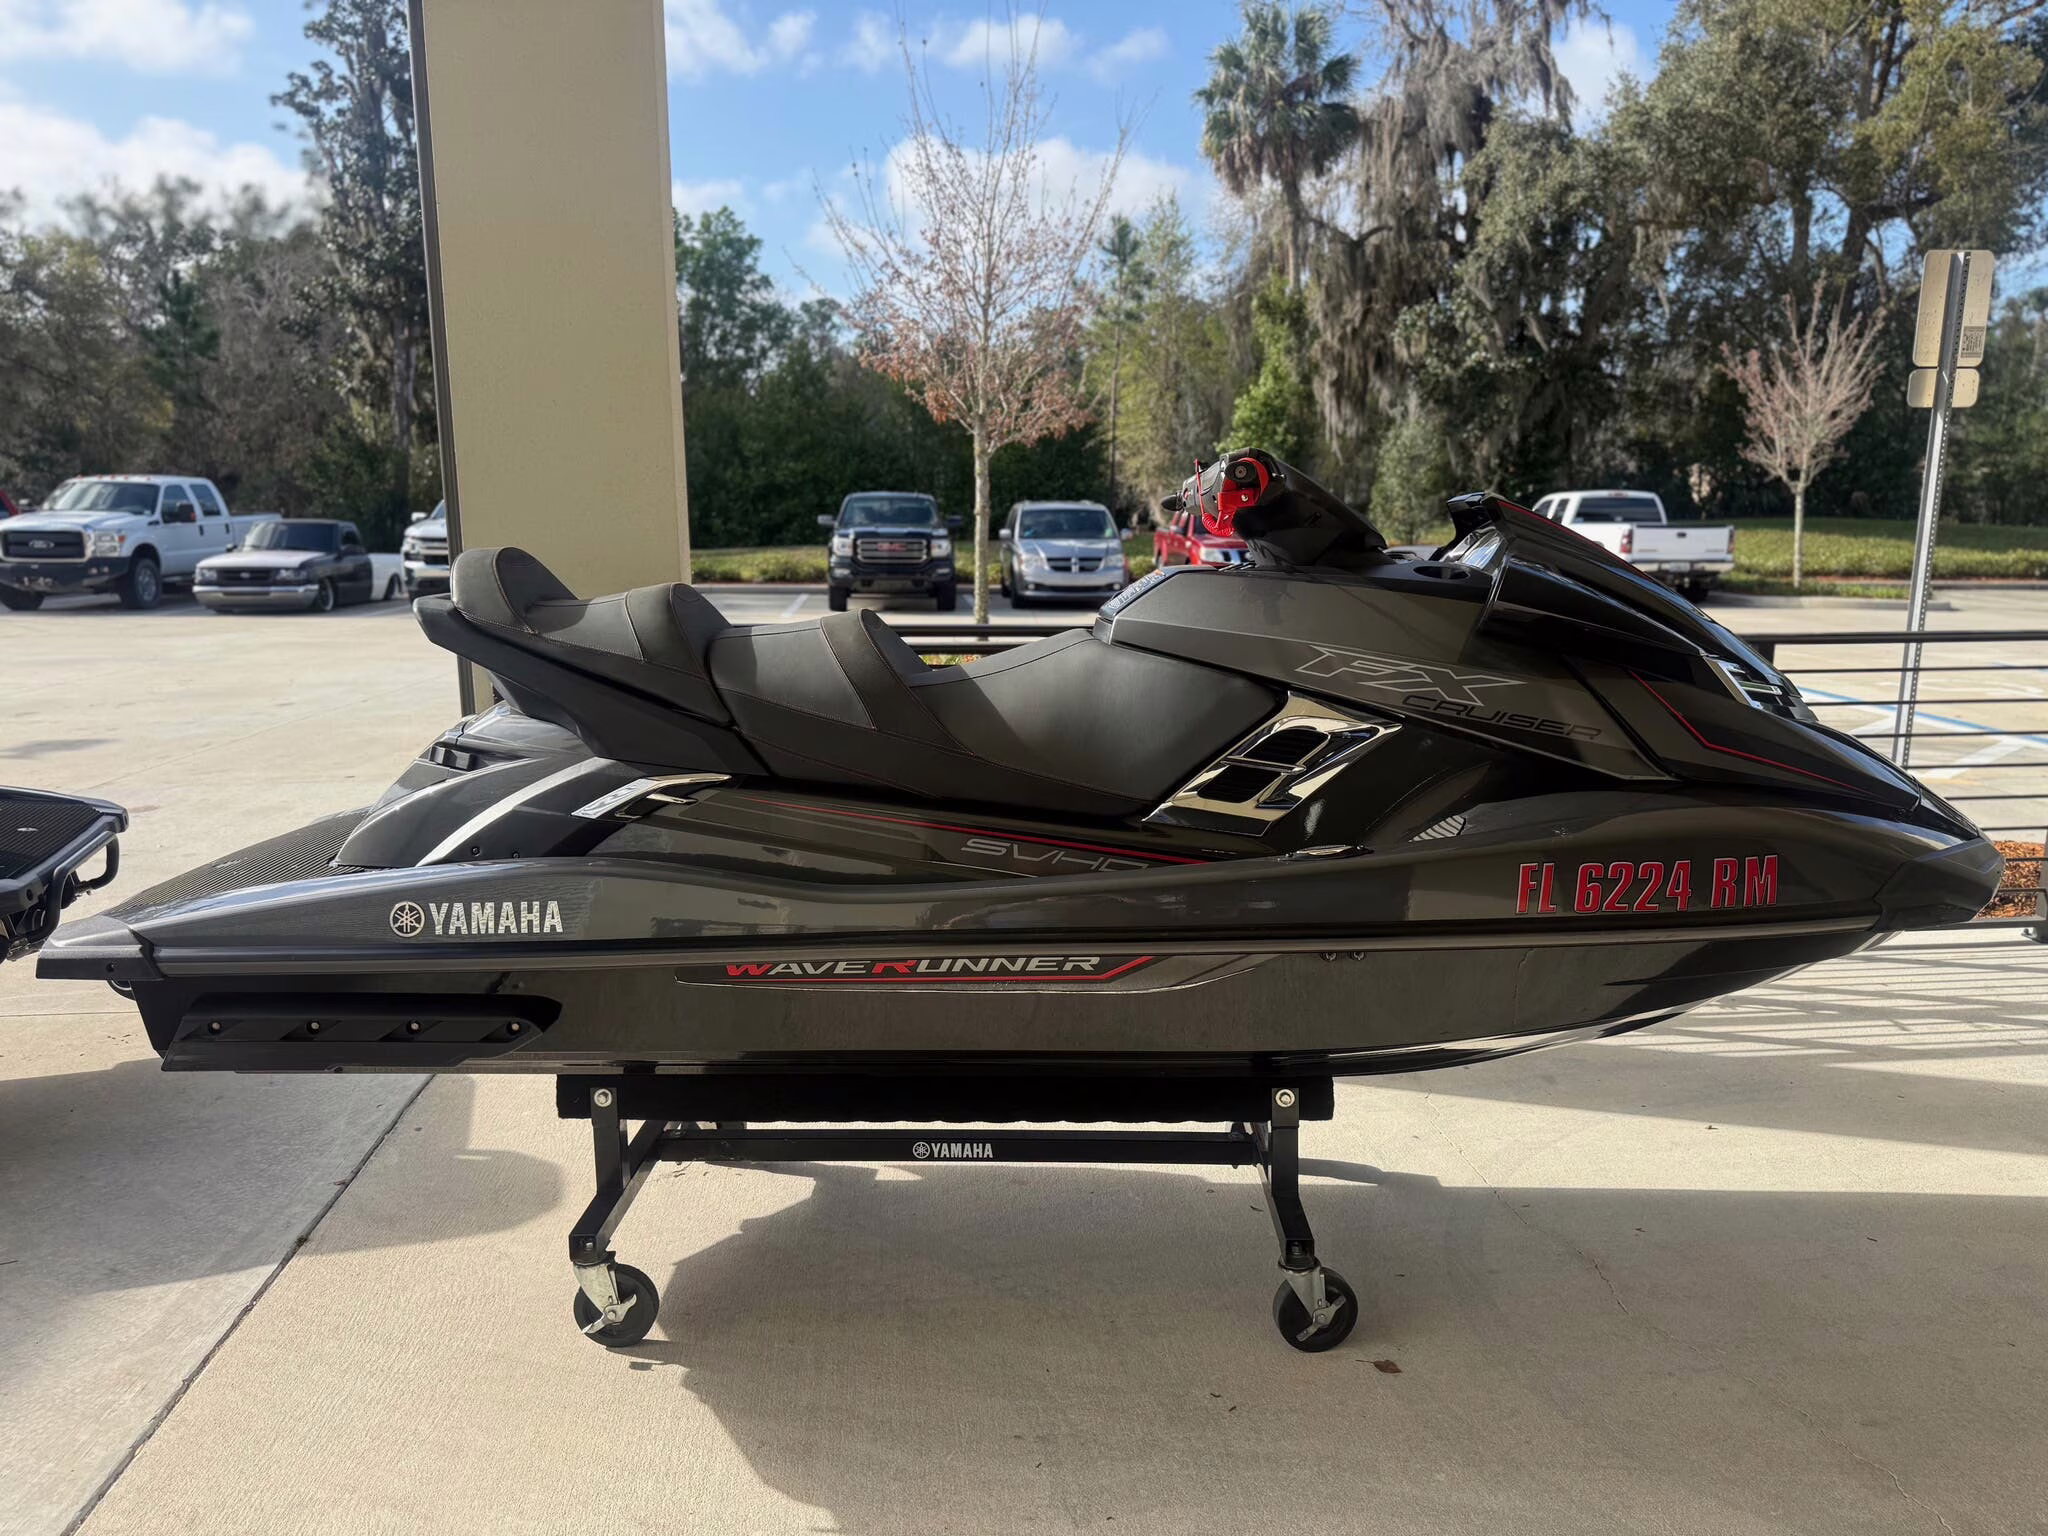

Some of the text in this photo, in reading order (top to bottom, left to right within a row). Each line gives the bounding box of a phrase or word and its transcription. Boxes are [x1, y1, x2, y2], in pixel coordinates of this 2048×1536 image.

[1294, 645, 1528, 706] FX
[1401, 694, 1602, 739] CRUISER
[1515, 854, 1779, 914] FL 6224 RM
[429, 900, 564, 935] YAMAHA
[726, 956, 1101, 977] WAVERUNNER
[930, 1142, 994, 1159] YAMAHA
